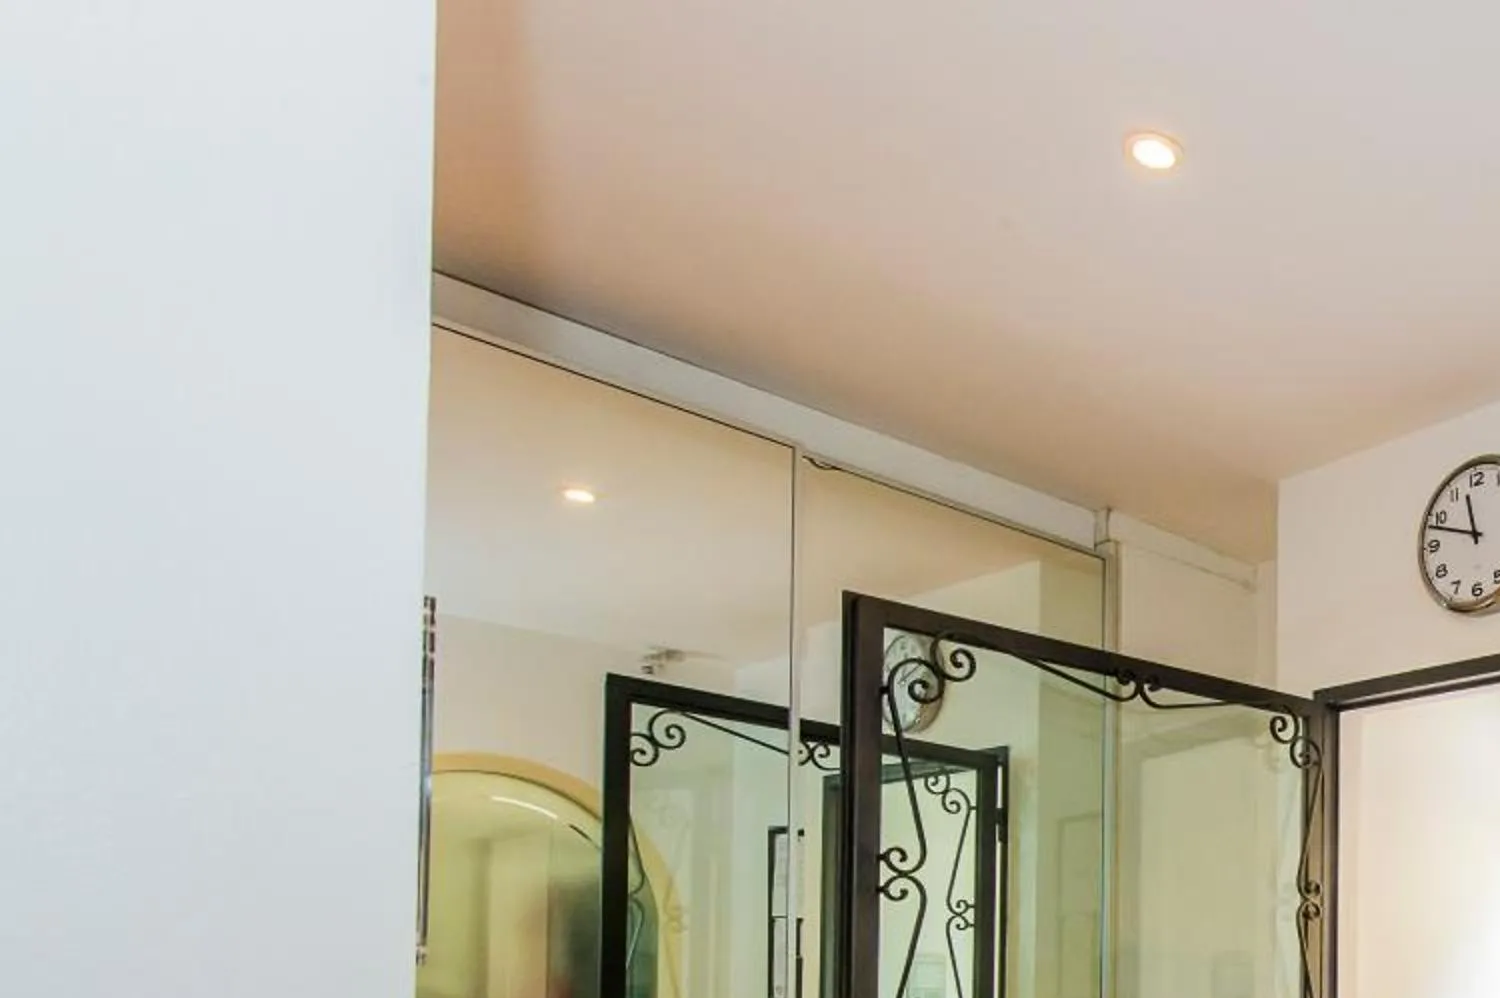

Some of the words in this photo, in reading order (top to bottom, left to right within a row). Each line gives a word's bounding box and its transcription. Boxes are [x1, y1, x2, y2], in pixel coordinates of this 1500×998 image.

[1469, 471, 1485, 488] 12
[1435, 510, 1447, 525] 10
[1427, 539, 1441, 553] 9
[1435, 563, 1449, 578] 8
[1451, 580, 1461, 595] 7
[1471, 583, 1483, 597] 6
